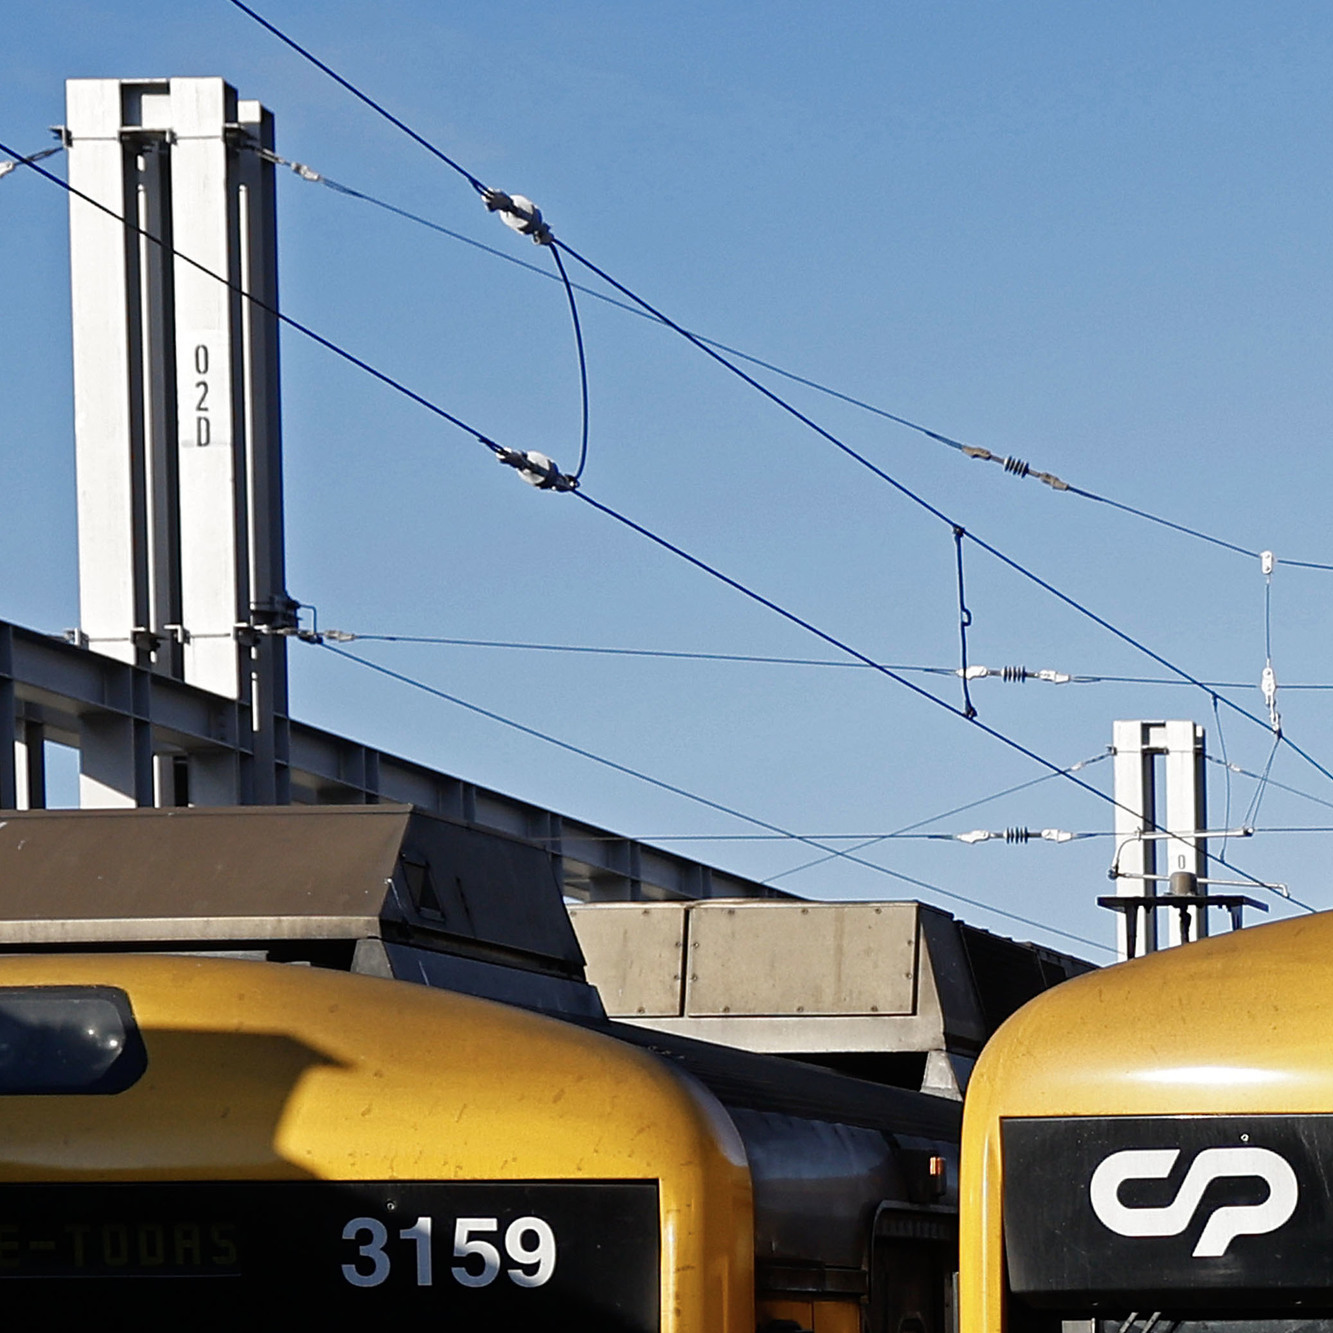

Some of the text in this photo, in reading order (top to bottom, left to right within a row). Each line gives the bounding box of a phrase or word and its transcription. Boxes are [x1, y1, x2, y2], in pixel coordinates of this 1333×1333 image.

[194, 343, 211, 448] 02D
[341, 1216, 556, 1288] 3159
[1090, 1147, 1299, 1257] CP
